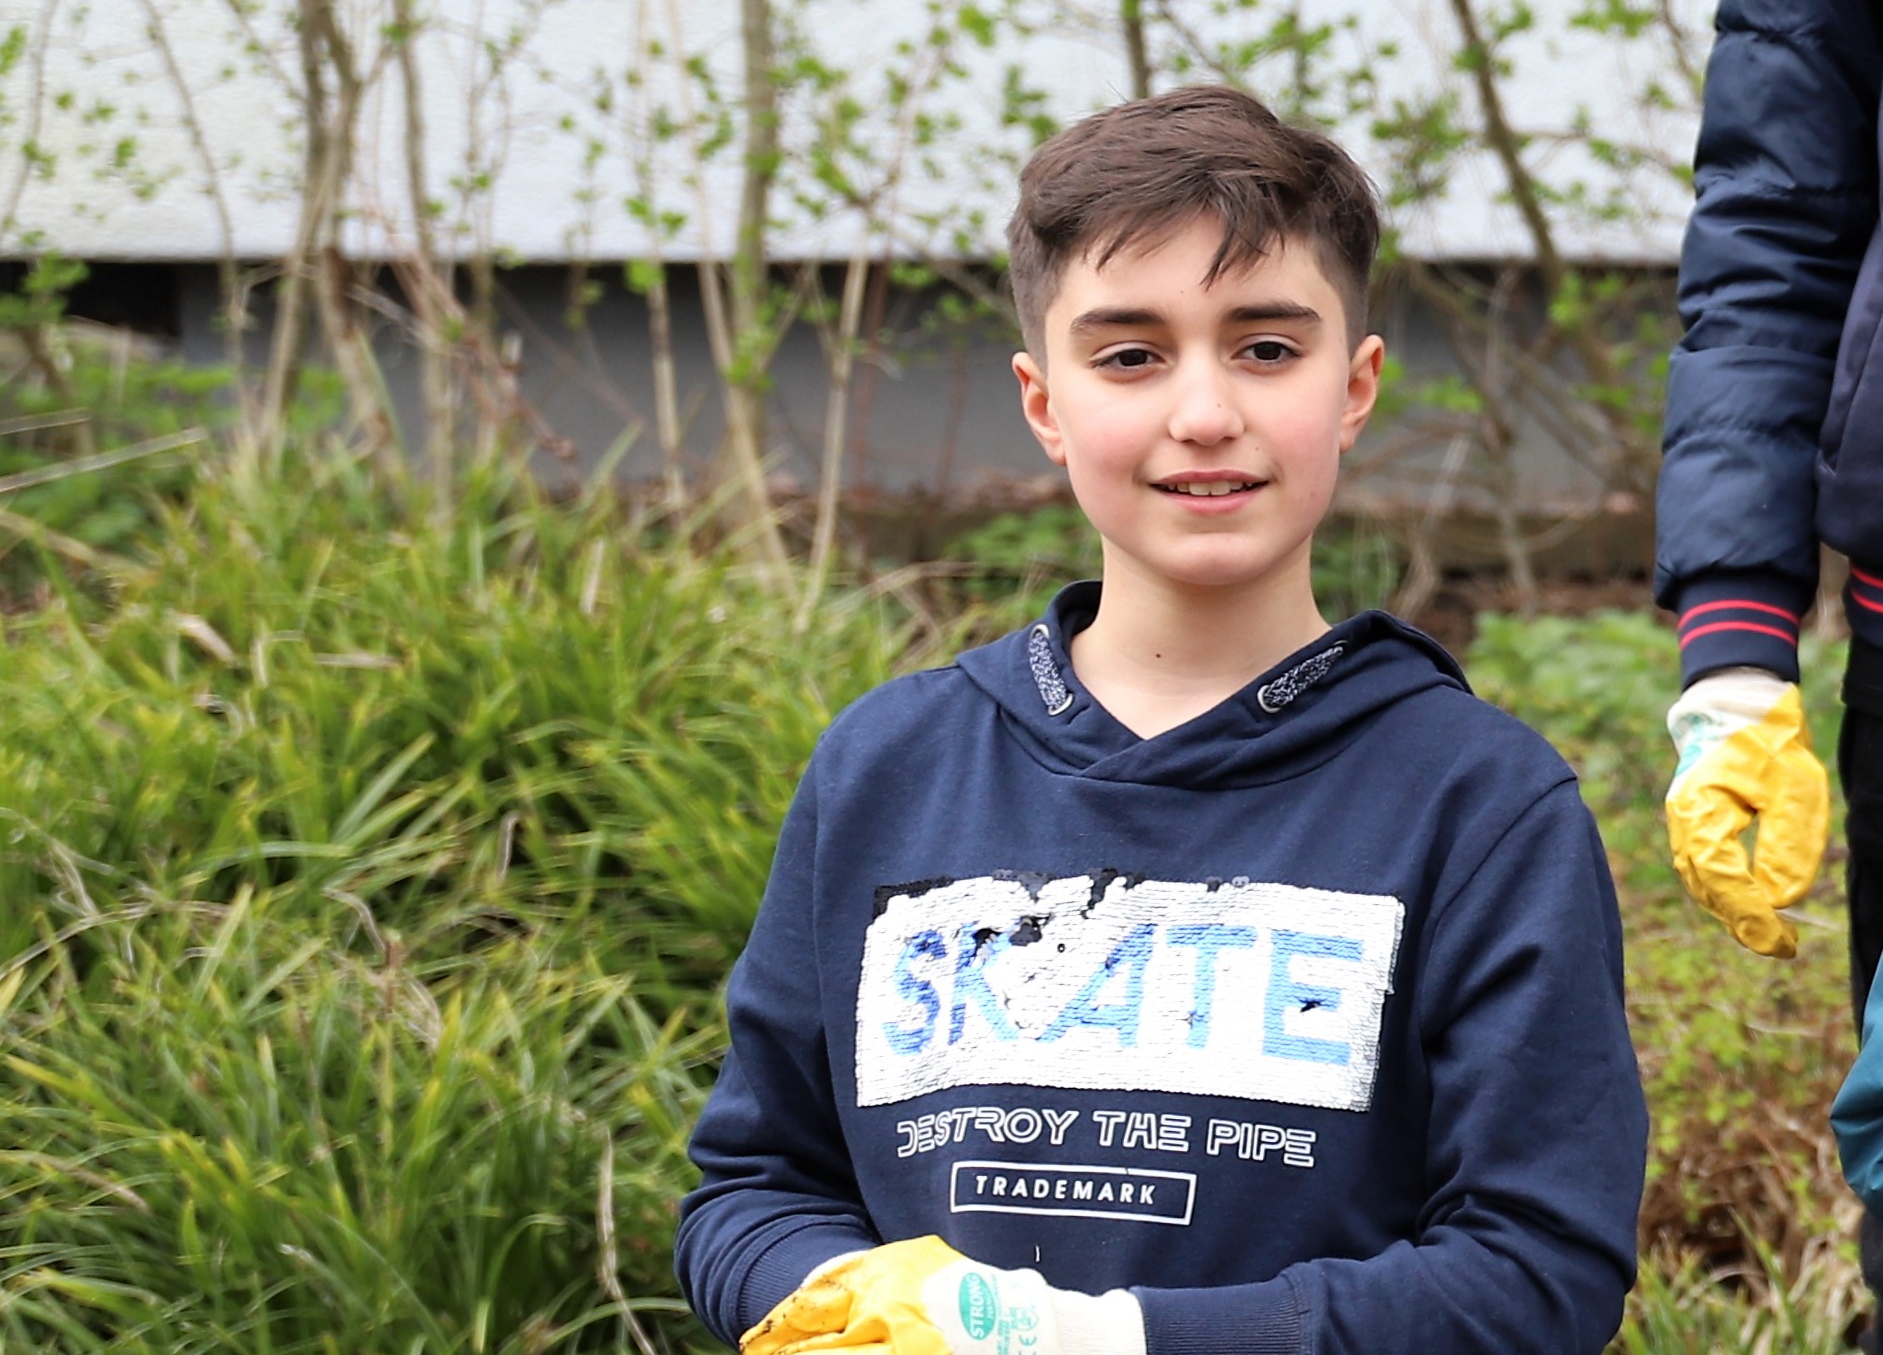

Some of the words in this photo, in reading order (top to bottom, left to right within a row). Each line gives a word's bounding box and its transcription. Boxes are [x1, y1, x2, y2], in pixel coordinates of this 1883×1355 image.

[882, 920, 1366, 1066] SKATE
[896, 1106, 1080, 1158] DESTROY
[1092, 1110, 1192, 1152] THE
[1205, 1118, 1318, 1169] PIPE
[974, 1174, 1156, 1206] TRADEMARK
[966, 1276, 984, 1337] STRONG
